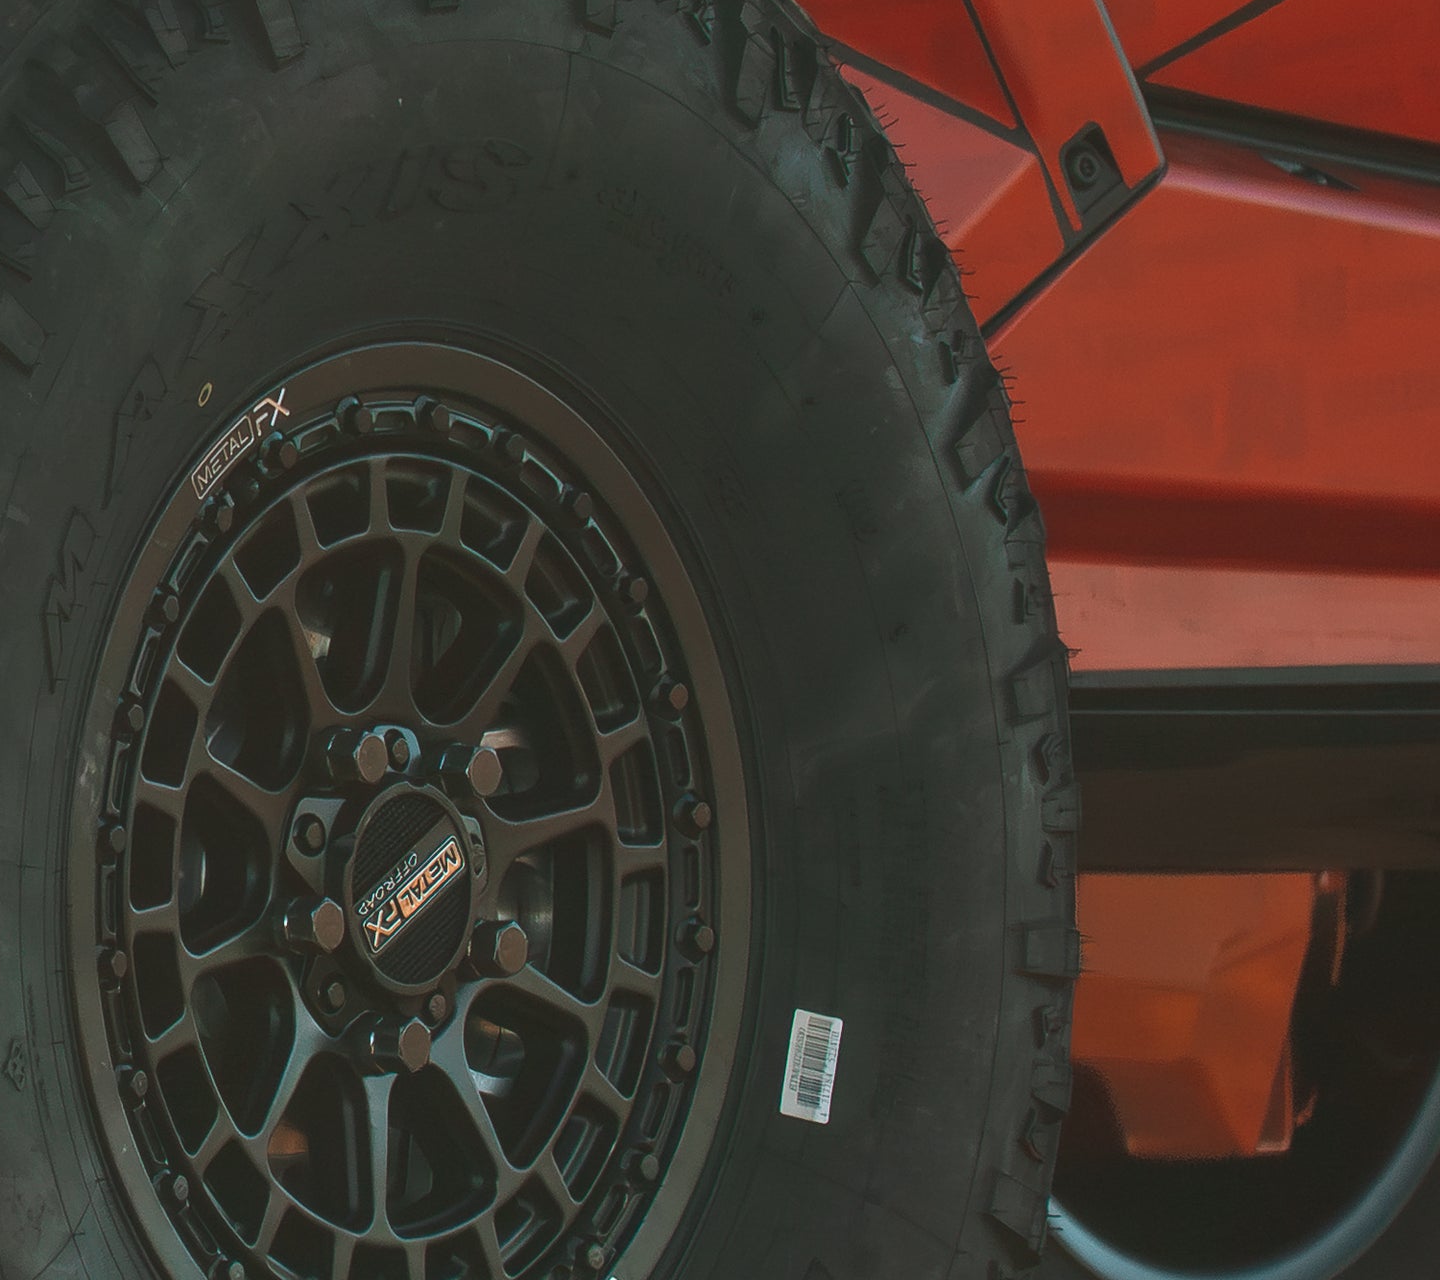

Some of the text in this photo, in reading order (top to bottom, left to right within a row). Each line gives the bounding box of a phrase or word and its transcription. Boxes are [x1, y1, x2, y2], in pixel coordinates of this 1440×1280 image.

[197, 385, 291, 491] METAL FX
[357, 851, 419, 916] OFFROAD
[366, 845, 460, 948] METAL FX
